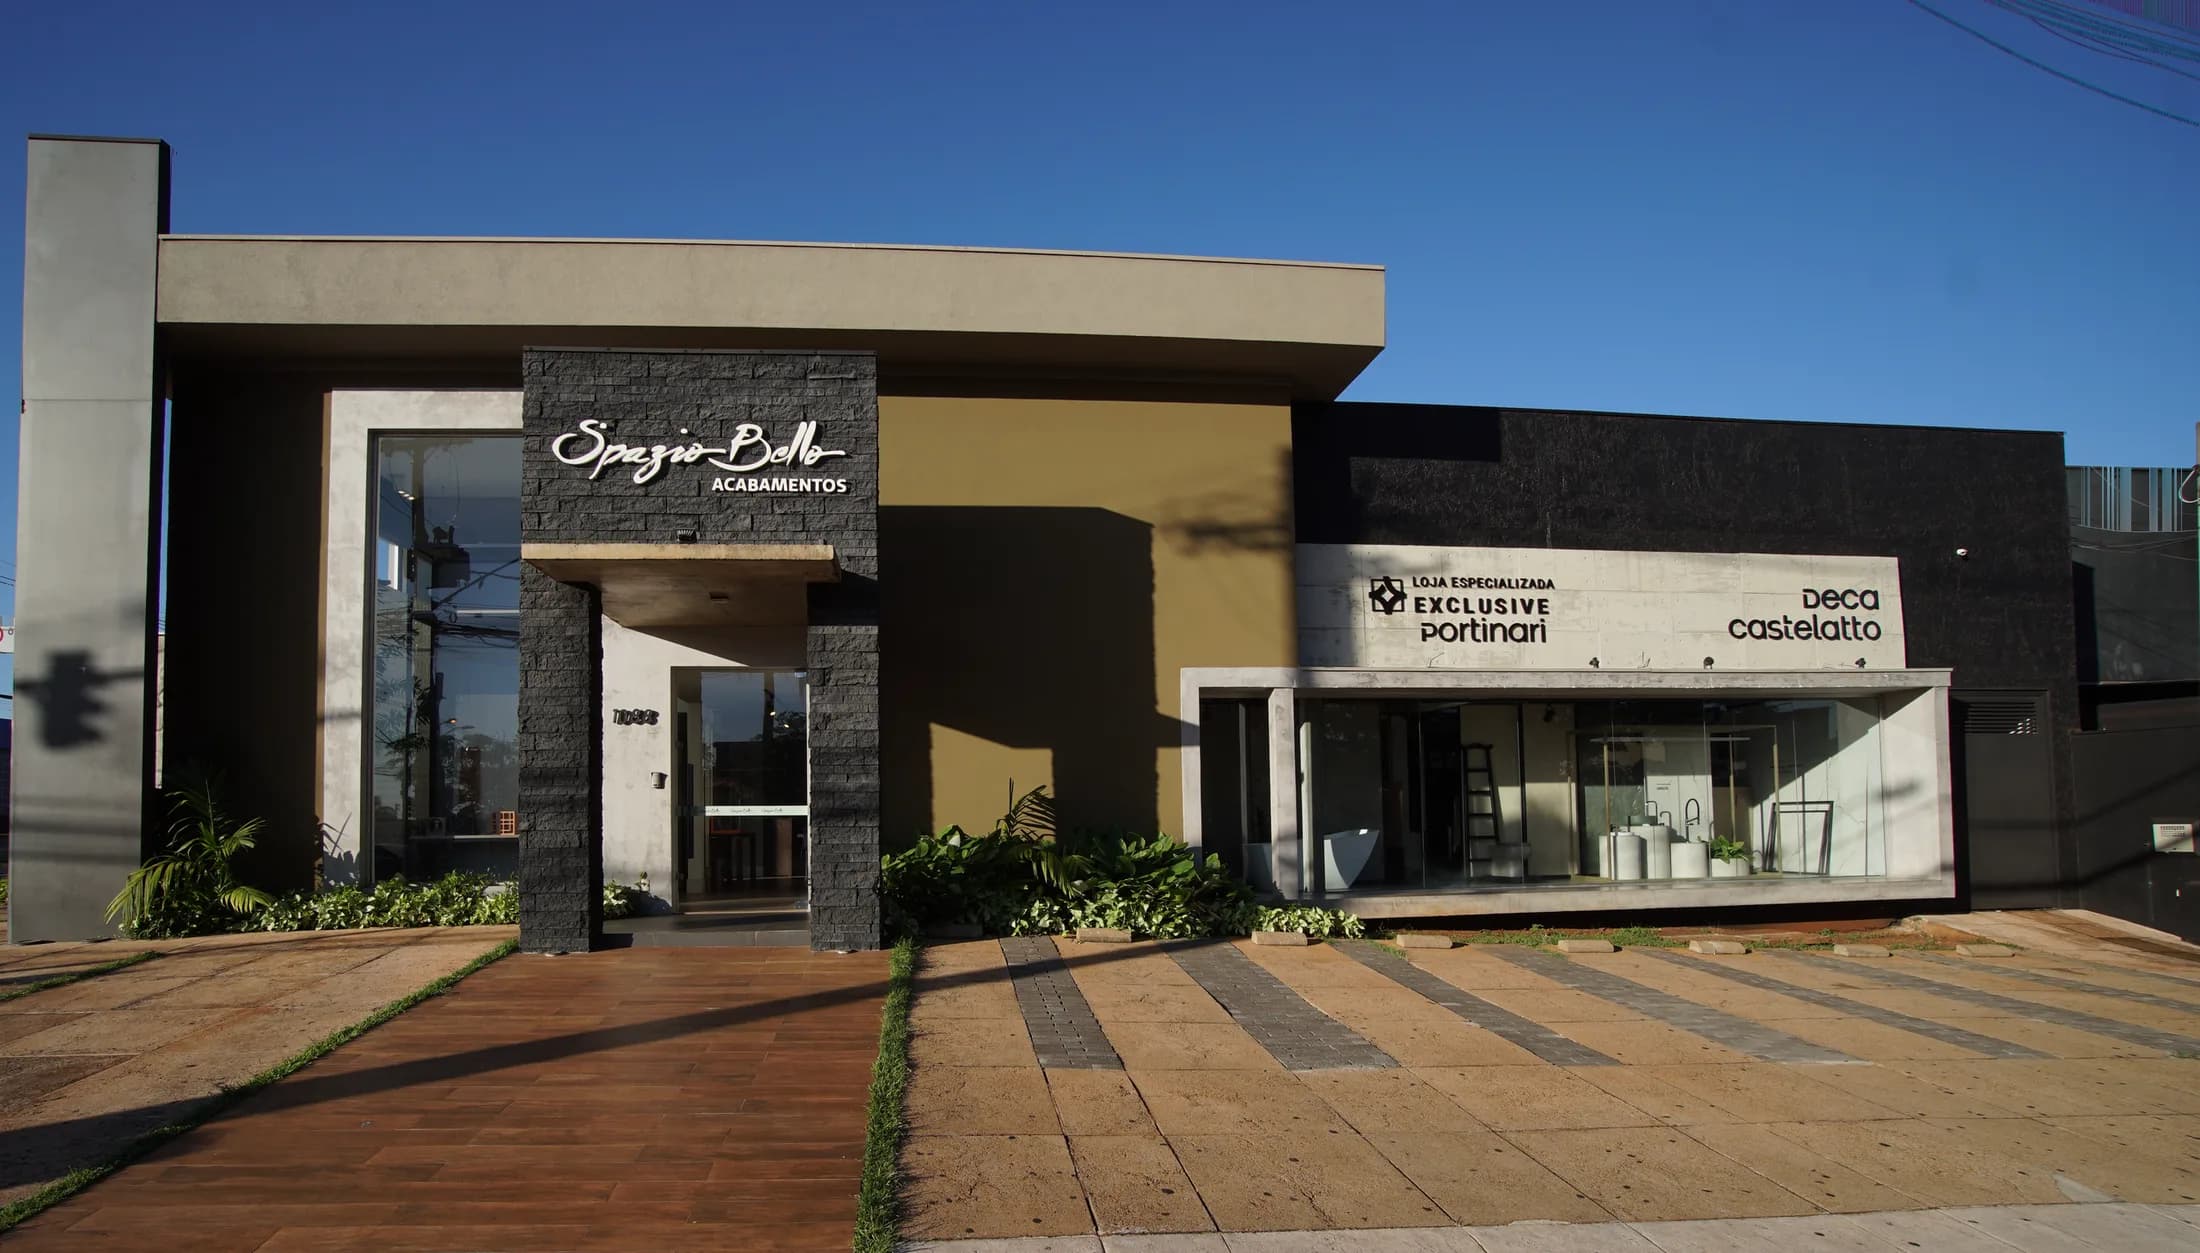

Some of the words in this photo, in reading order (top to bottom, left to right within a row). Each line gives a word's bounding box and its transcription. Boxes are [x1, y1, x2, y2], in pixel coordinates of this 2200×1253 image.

[552, 419, 726, 485] Spazio
[708, 420, 846, 472] Bello
[711, 477, 848, 494] ACABAMENTOS
[1412, 575, 1448, 588] LOJA
[1451, 576, 1556, 590] ESPECIALIZADA
[1414, 596, 1550, 615] EXCLUSIVE
[1802, 588, 1880, 611] Deca
[1728, 613, 1882, 641] castelatto
